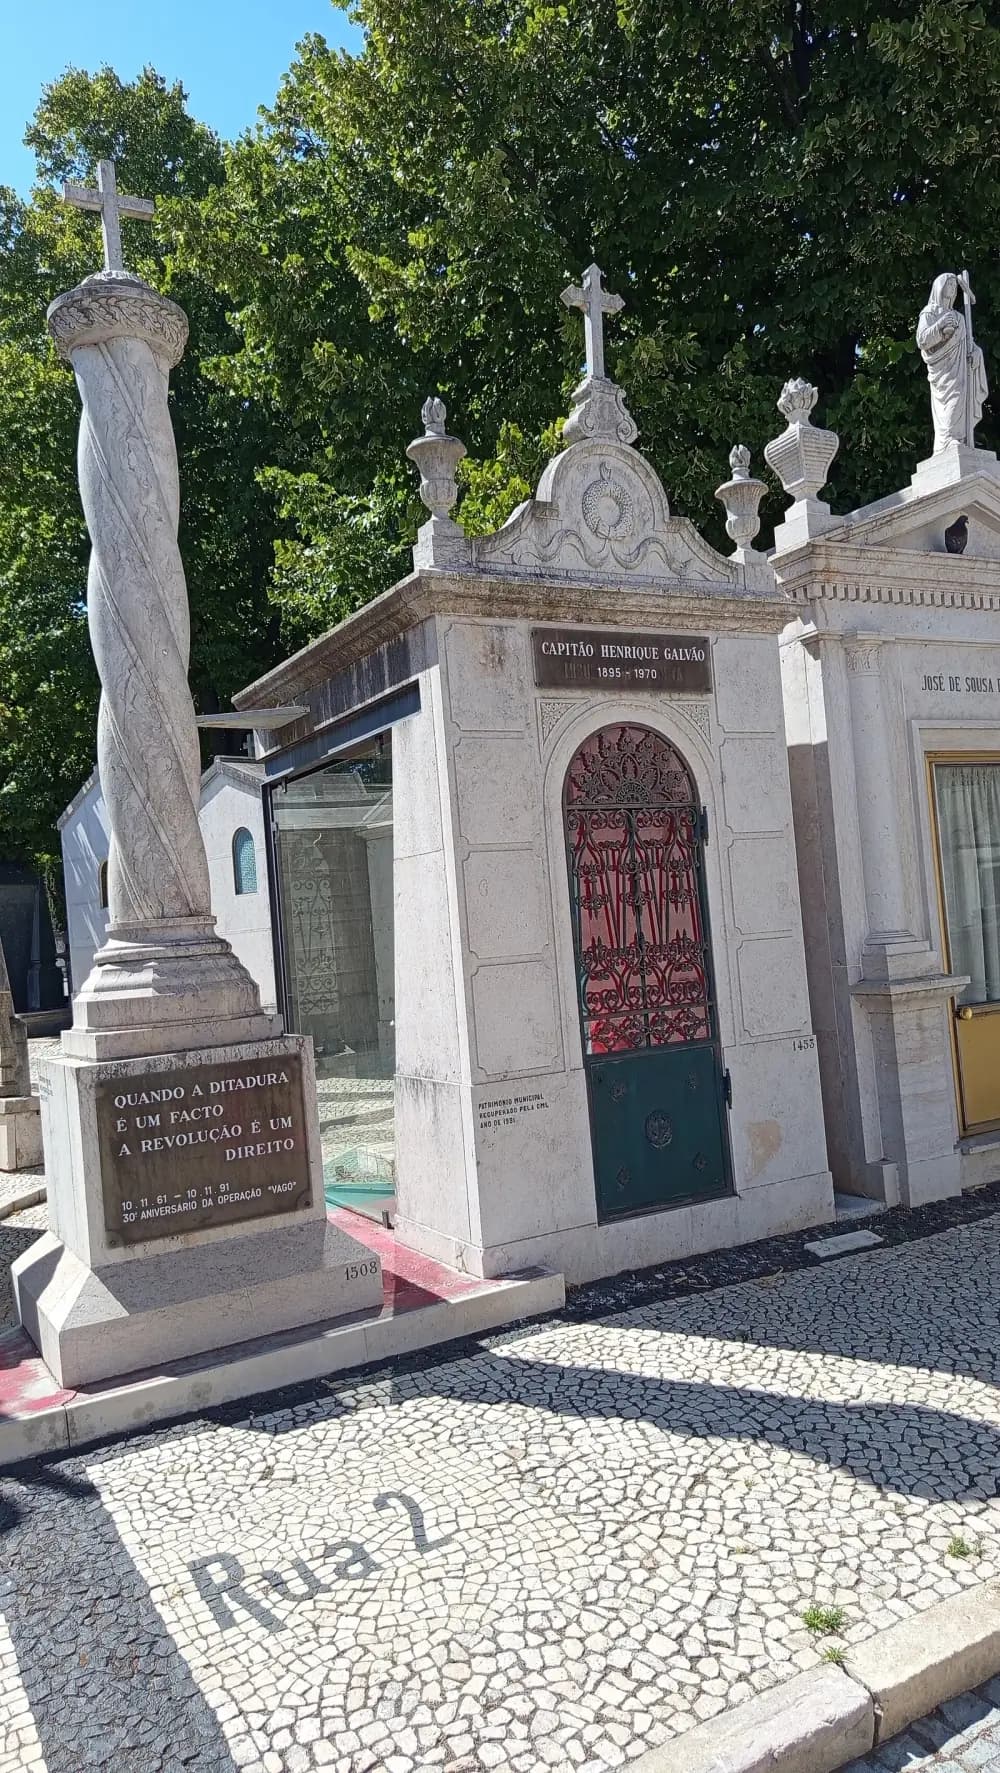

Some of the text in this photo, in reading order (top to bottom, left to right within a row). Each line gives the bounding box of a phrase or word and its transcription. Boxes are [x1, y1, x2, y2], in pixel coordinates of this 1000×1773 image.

[541, 641, 705, 662] CAPITÃO HENRIQUE GALVÃO
[597, 667, 621, 678] 1895
[634, 668, 657, 680] 1970
[921, 673, 945, 692] JOSÉ
[948, 676, 961, 692] DE
[965, 676, 994, 693] SOUSA
[114, 1071, 289, 1109] QUANDO A DITADURA
[514, 1093, 544, 1104] MUNICIPAL
[116, 1104, 224, 1133] É UM FACTO
[480, 1107, 518, 1118] RECUPERADO
[519, 1104, 535, 1112] PELA
[480, 1120, 492, 1128] ANO
[118, 1115, 293, 1157] A REVOLUÇÃO É UM
[225, 1137, 295, 1161] DIREITO
[201, 1197, 214, 1209] DA
[217, 1187, 262, 1205] OPERAÇÃO
[344, 1260, 378, 1281] 1508
[187, 1490, 458, 1634] Rua 2
